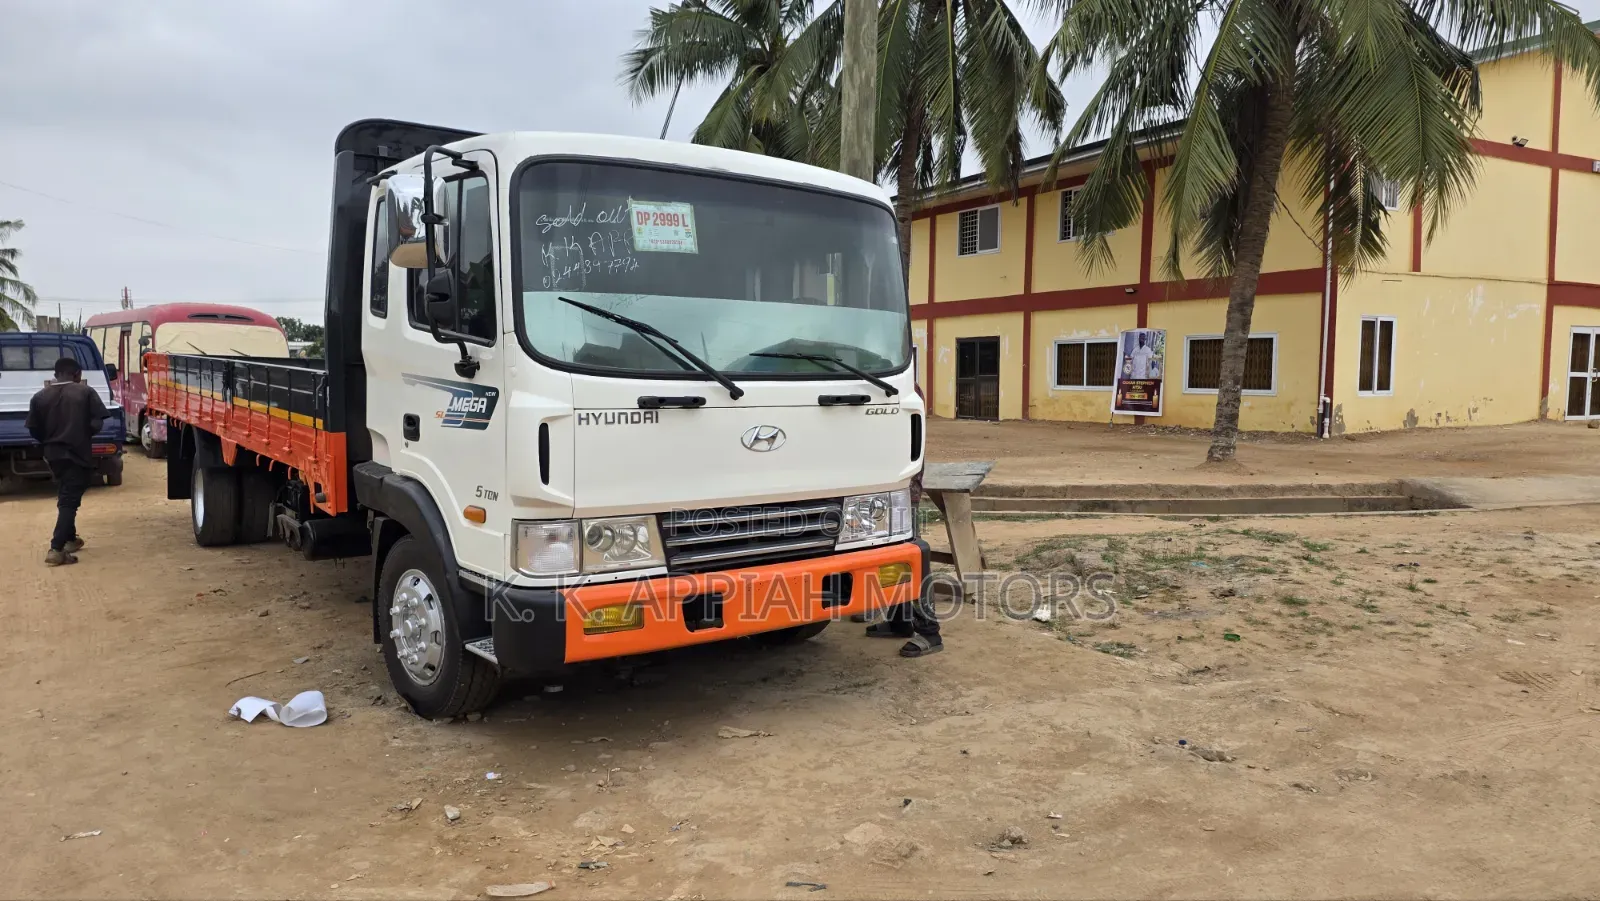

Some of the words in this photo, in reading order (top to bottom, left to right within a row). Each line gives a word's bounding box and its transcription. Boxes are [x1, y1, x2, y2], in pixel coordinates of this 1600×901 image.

[636, 211, 650, 226] DP
[652, 212, 680, 227] 2999
[681, 213, 689, 228] L
[449, 396, 488, 414] MEGA
[865, 407, 900, 416] GOLD
[577, 410, 659, 426] HYUNDAI
[475, 485, 483, 498] 5
[484, 489, 499, 502] TON
